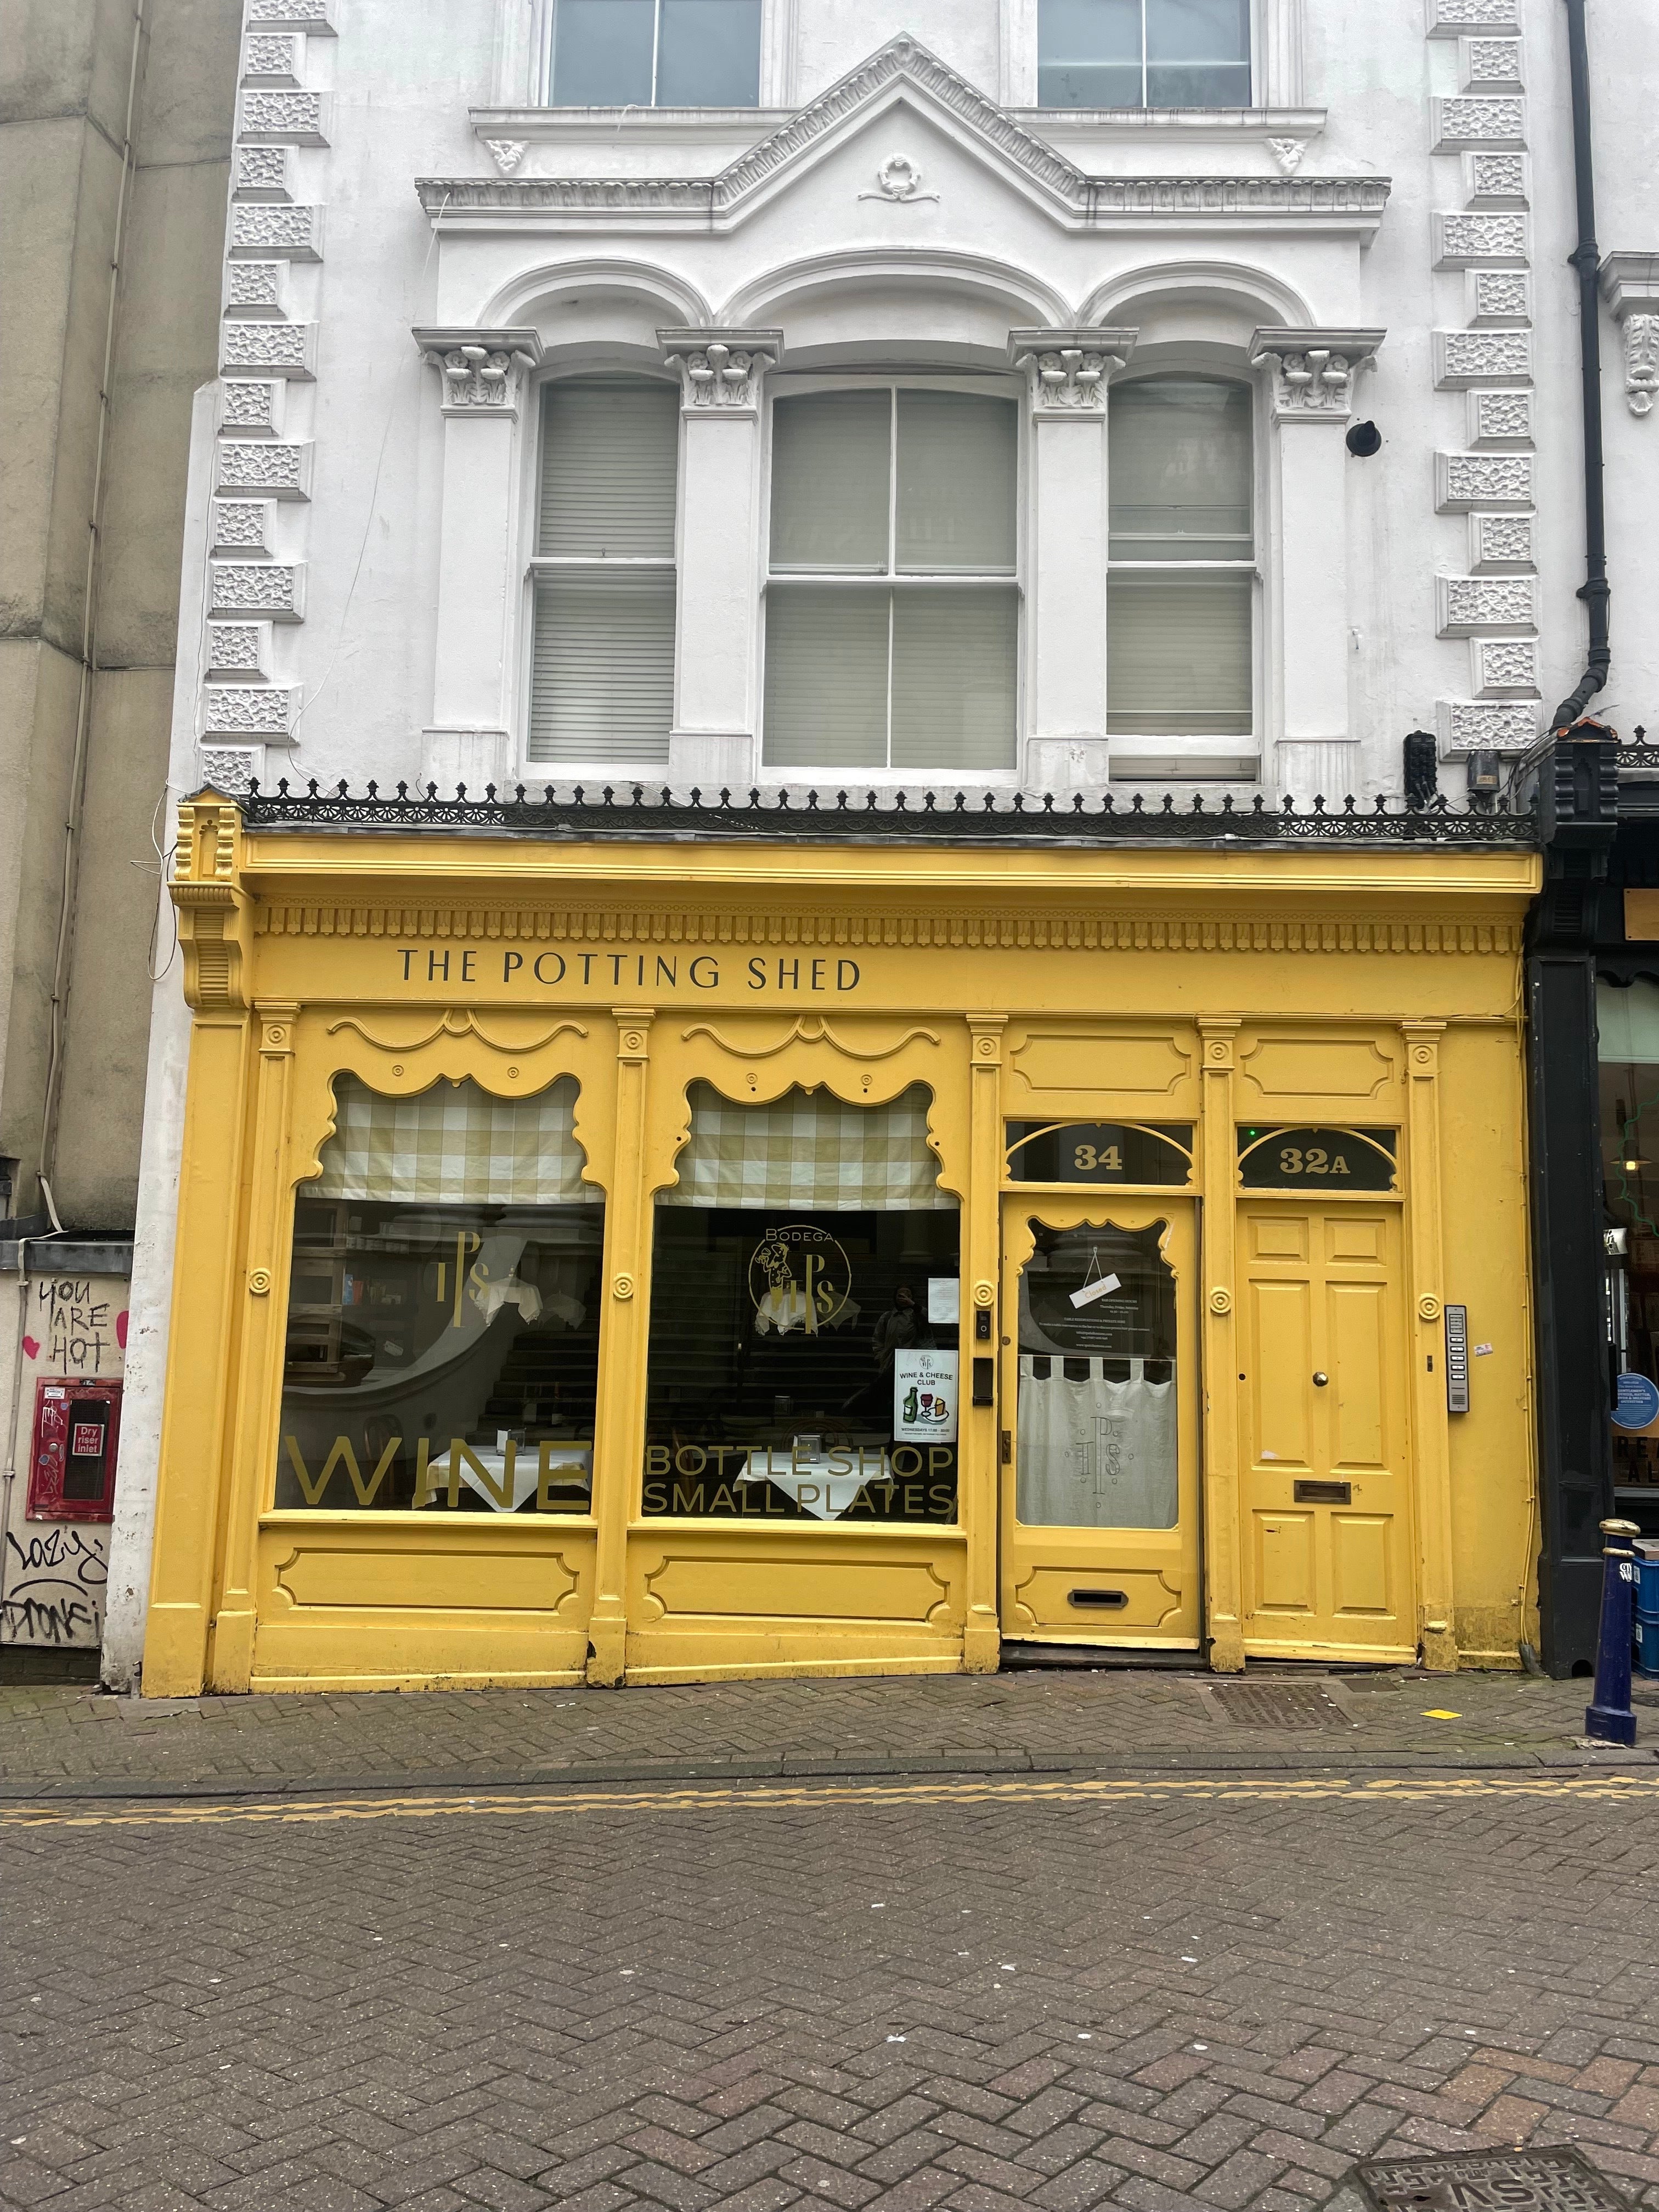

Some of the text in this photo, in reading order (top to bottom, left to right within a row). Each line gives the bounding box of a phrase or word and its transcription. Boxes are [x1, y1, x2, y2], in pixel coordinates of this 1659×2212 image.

[397, 949, 861, 991] THE POTTING SHED
[1074, 1144, 1123, 1170] 34
[1279, 1148, 1351, 1175] 32A
[1085, 1285, 1107, 1299] Closed
[54, 1303, 110, 1333] ARE
[52, 1332, 110, 1375] HOT
[926, 1372, 953, 1380] CHEESE
[81, 1427, 98, 1437] Dry
[77, 1444, 98, 1453] inlet
[645, 1444, 954, 1477] BOTTLE SHOP
[1617, 1436, 1659, 1458] RE
[284, 1436, 592, 1510] WINE
[642, 1483, 955, 1514] SMALL PLATES
